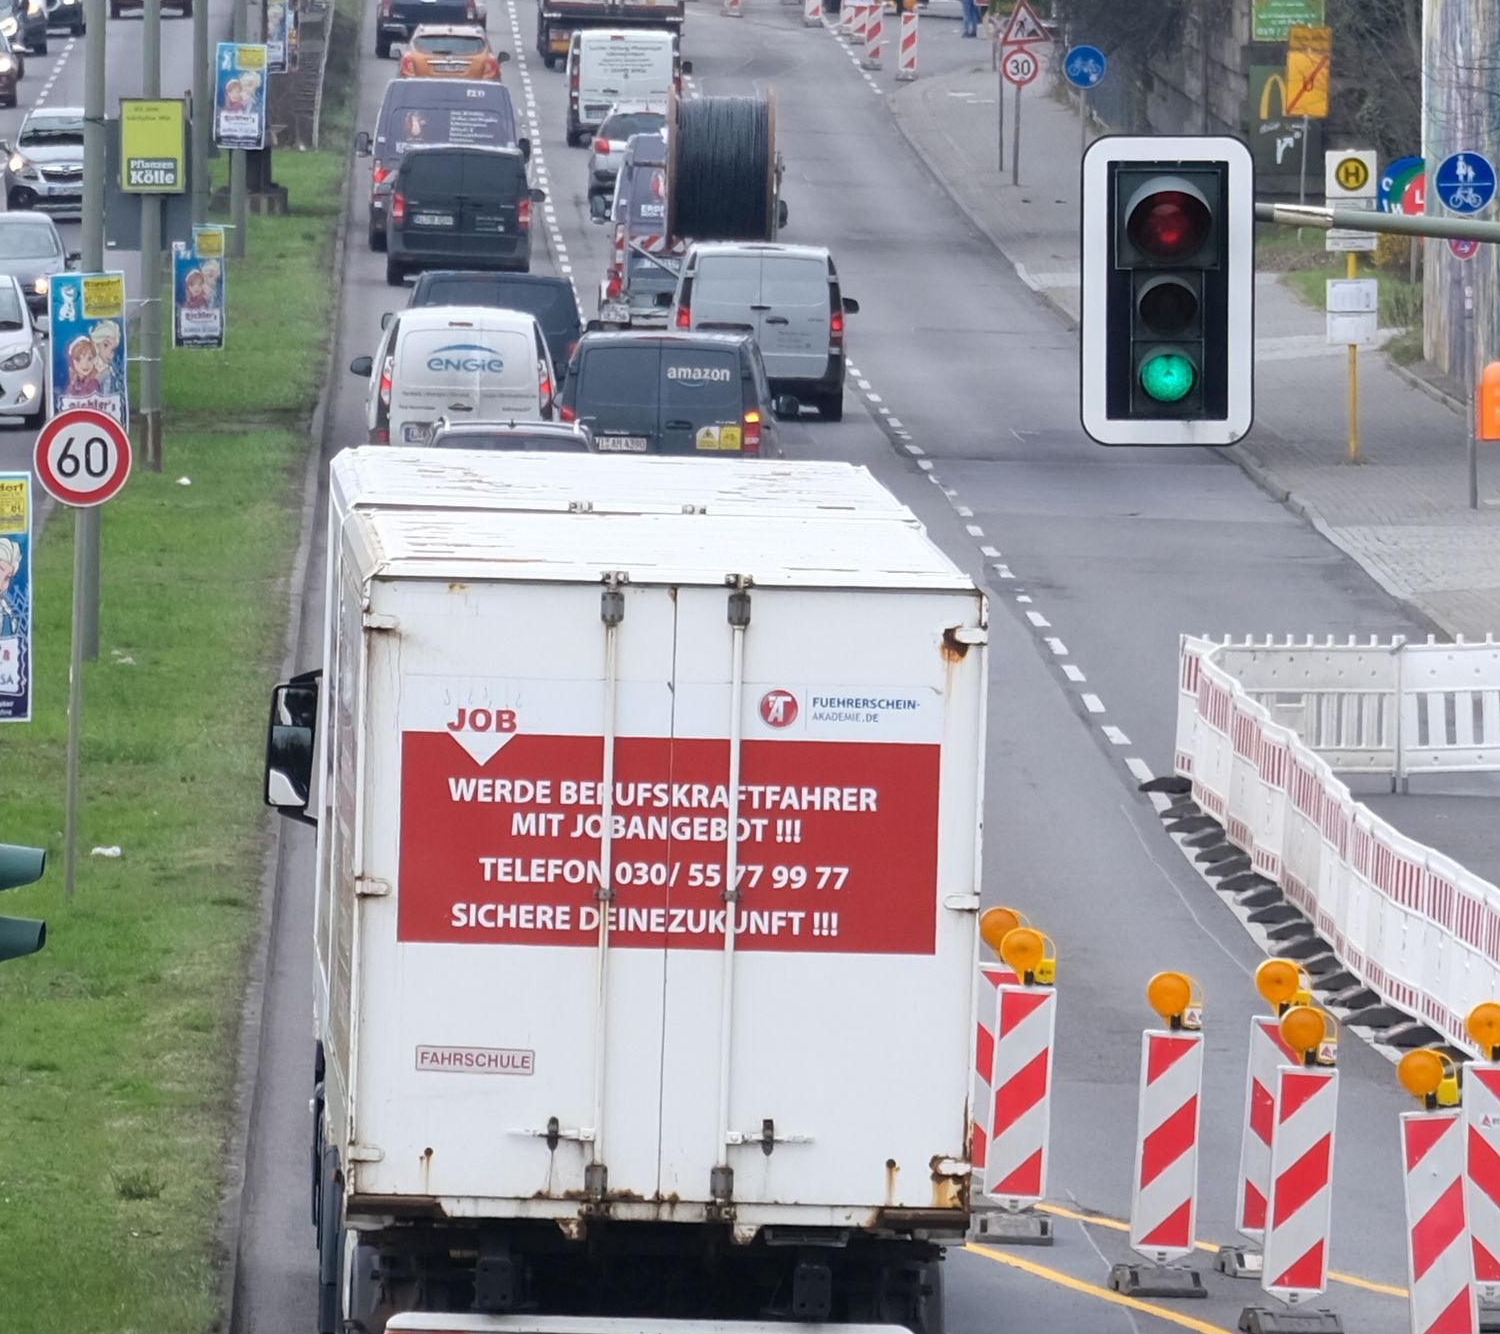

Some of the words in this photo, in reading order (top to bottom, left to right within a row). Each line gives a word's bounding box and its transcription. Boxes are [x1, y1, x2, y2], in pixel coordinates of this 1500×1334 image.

[1010, 61, 1030, 76] 30
[130, 170, 175, 185] Kölle
[667, 366, 731, 383] amazon
[57, 437, 109, 478] 60
[812, 696, 922, 713] FUEHRERSCHEIN-
[448, 708, 519, 734] JOB
[812, 711, 880, 725] AKADEMIE.DE
[449, 778, 552, 805] WERDE
[511, 812, 565, 839] MIT
[571, 813, 769, 844] JOBANGEBOT
[479, 857, 604, 885] TELEFON
[615, 861, 681, 889] 030/
[687, 862, 722, 889] 55
[772, 865, 808, 891] 99
[815, 866, 850, 892] 77
[451, 902, 571, 931] SICHERE
[419, 1050, 532, 1071] FAHRSCHULE
